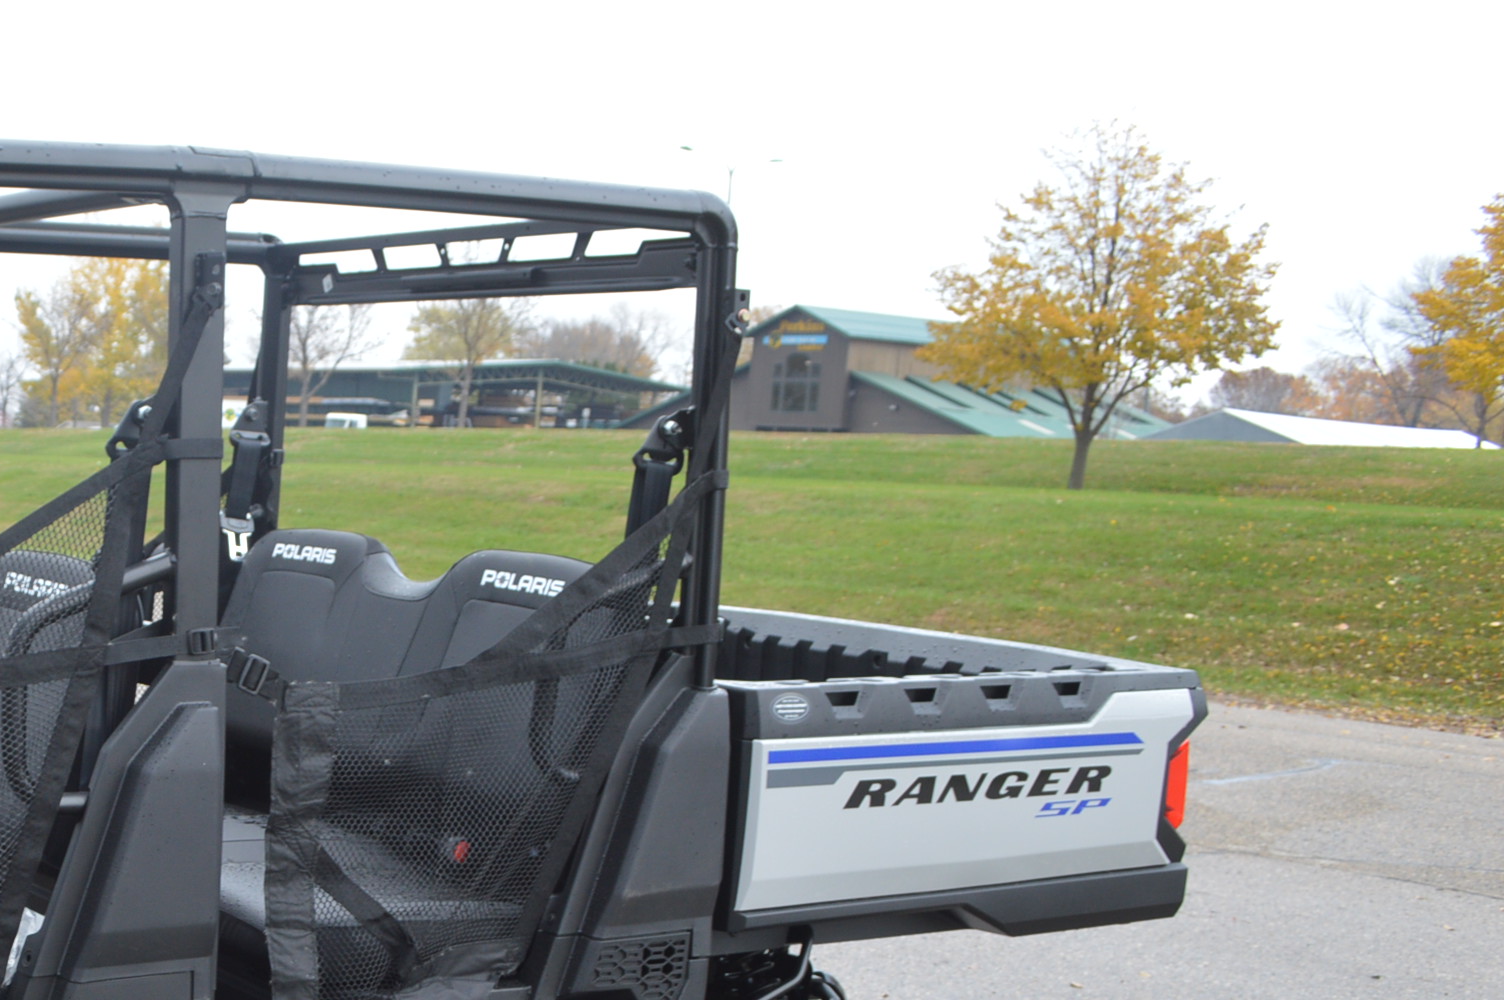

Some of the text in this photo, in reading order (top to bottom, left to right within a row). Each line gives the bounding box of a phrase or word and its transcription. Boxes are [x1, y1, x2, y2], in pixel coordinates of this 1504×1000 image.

[272, 542, 336, 565] POLARIS
[480, 569, 566, 597] POLARIS
[842, 765, 1112, 810] RANGER
[1034, 797, 1112, 818] SP
